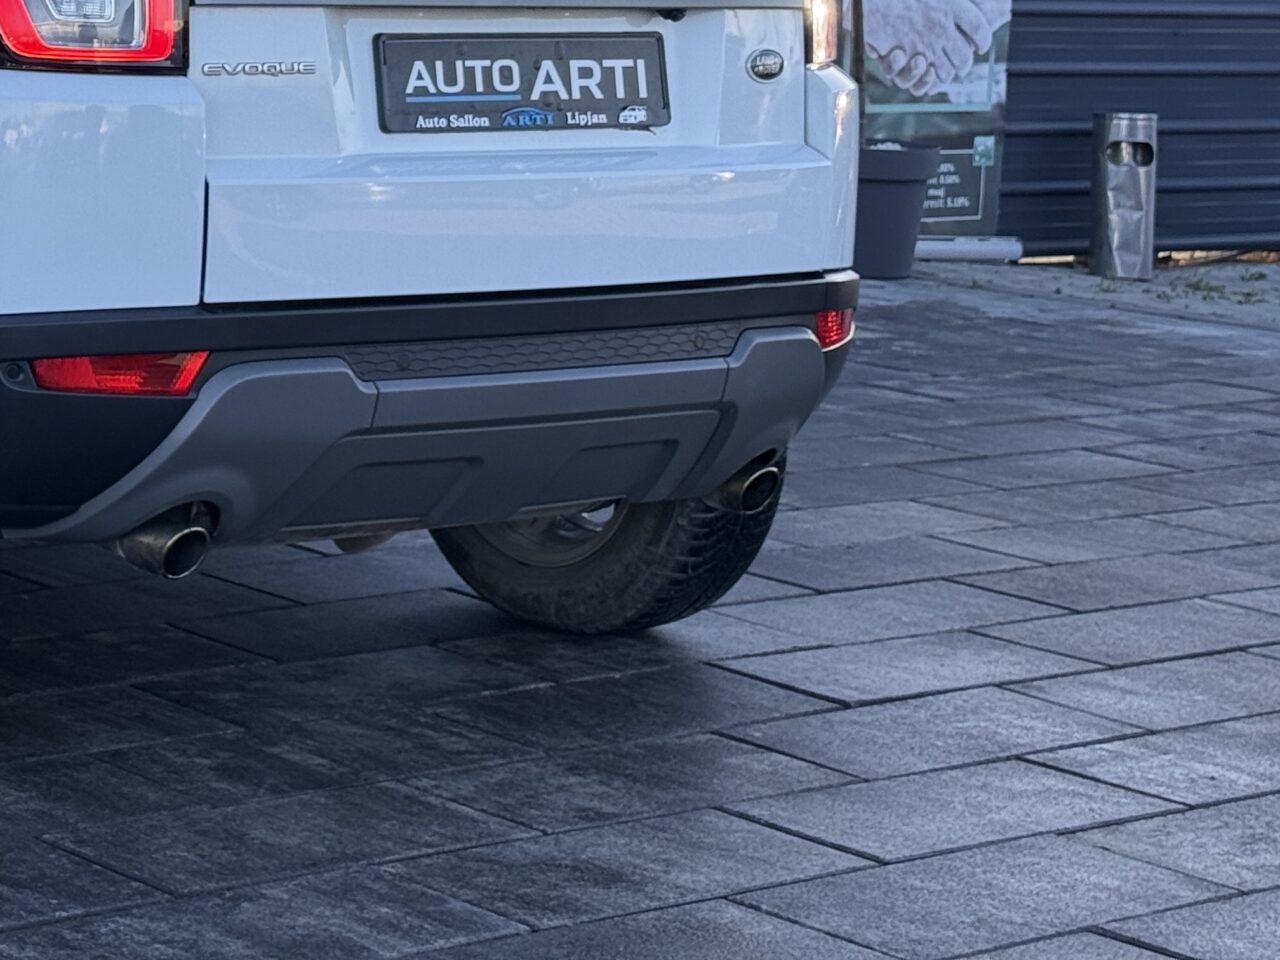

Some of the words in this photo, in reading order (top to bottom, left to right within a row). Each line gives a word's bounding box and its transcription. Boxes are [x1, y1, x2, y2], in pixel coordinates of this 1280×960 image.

[202, 61, 317, 77] EVOQUE
[405, 58, 520, 95] AUTO
[530, 58, 648, 100] ARTI
[416, 115, 447, 128] Auto
[449, 114, 490, 127] Sallon
[503, 114, 553, 126] ARTI
[566, 112, 607, 126] Lipjan
